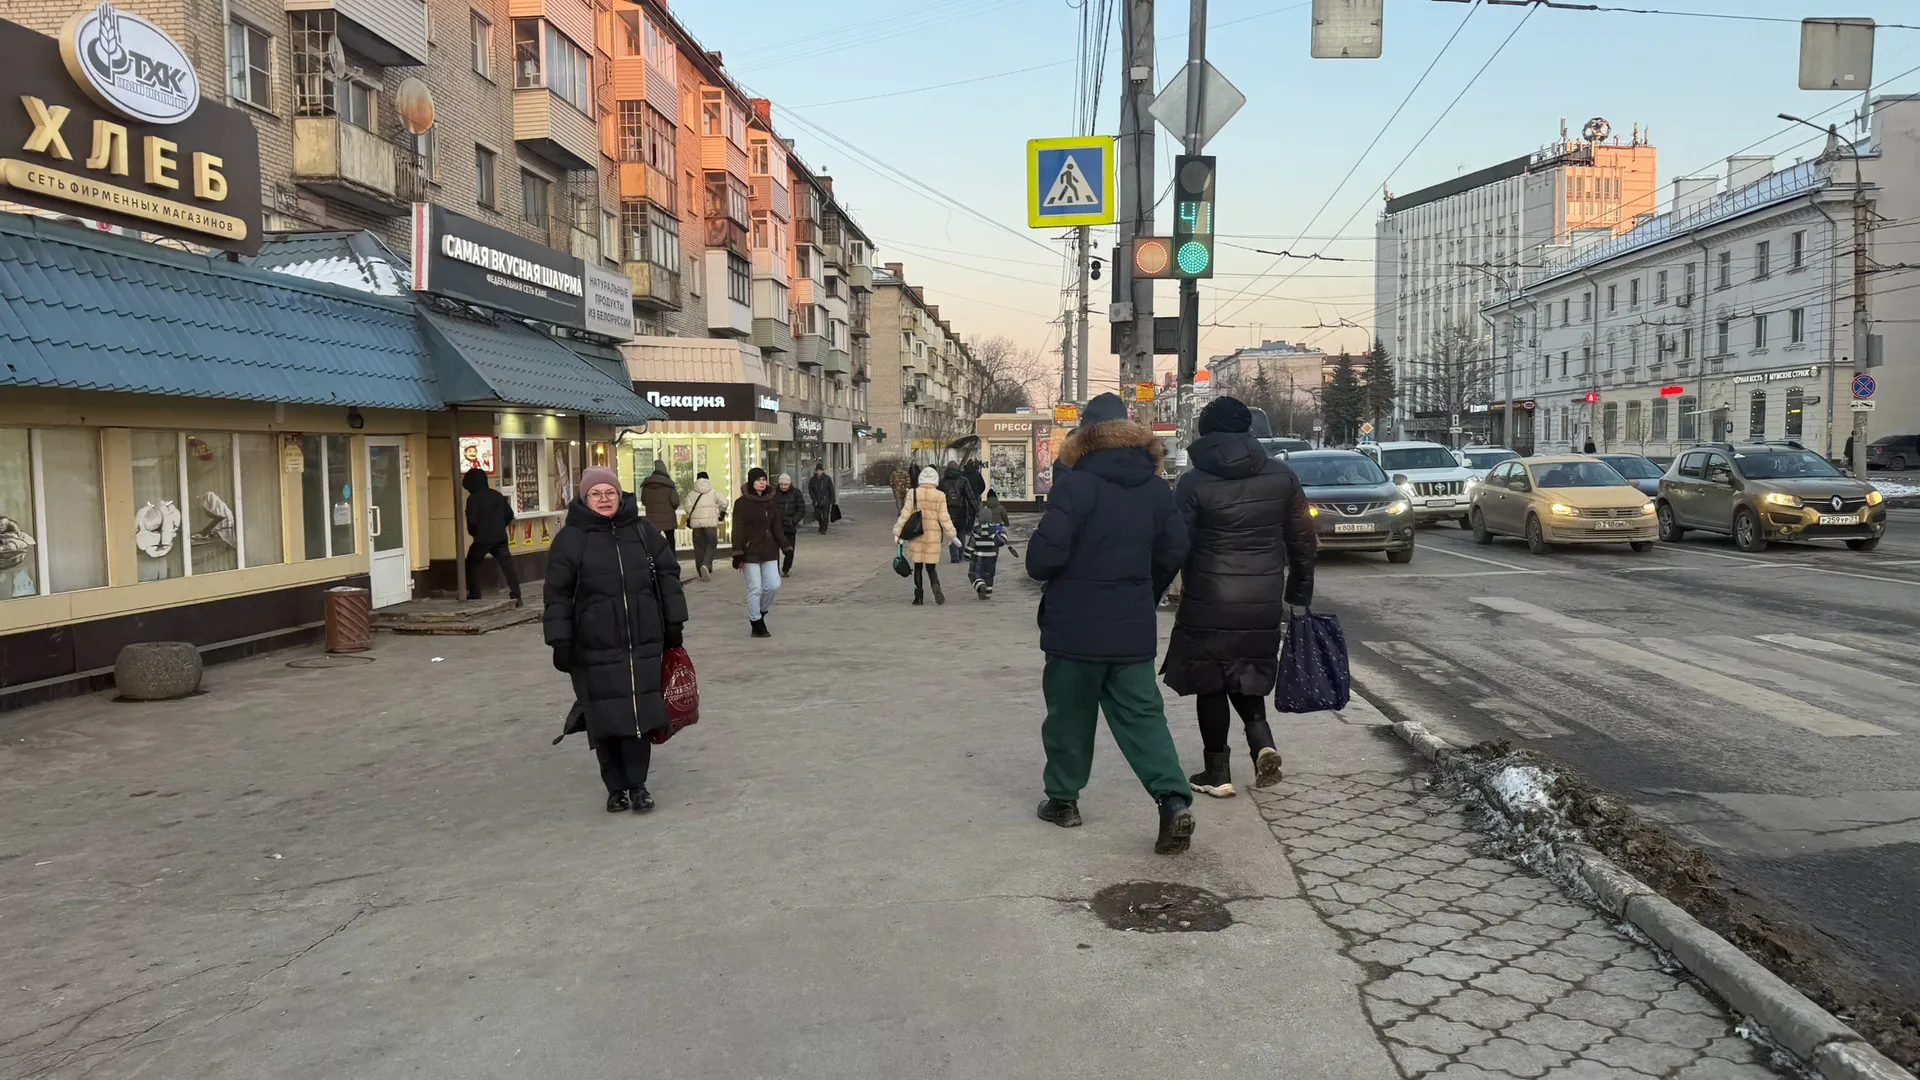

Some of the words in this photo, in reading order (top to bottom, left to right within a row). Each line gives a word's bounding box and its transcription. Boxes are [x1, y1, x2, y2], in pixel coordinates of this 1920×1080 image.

[20, 95, 229, 201] ХЛЕБ
[27, 171, 65, 190] СЕТЬ
[69, 181, 159, 213] ФИРМЕННЫХ
[162, 205, 233, 232] МАГАЗИНОВ
[1180, 201, 1211, 233] 41
[442, 234, 489, 267] САМАЯ
[491, 249, 541, 285] ВКУСНАЯ
[486, 273, 523, 292] ФЕДЕРАЛЬНАЯ
[522, 283, 535, 295] СЕТЬ
[535, 286, 548, 299] КАФЕ
[589, 275, 629, 298] НАТУРАЛЬНЫЕ
[594, 293, 625, 312] ПРОДУКТЫ
[588, 307, 596, 320] ИЗ
[597, 310, 631, 328] БЕЛОРУССИИ
[647, 391, 726, 412] Пекарня
[994, 422, 1033, 432] ПРЕССА
